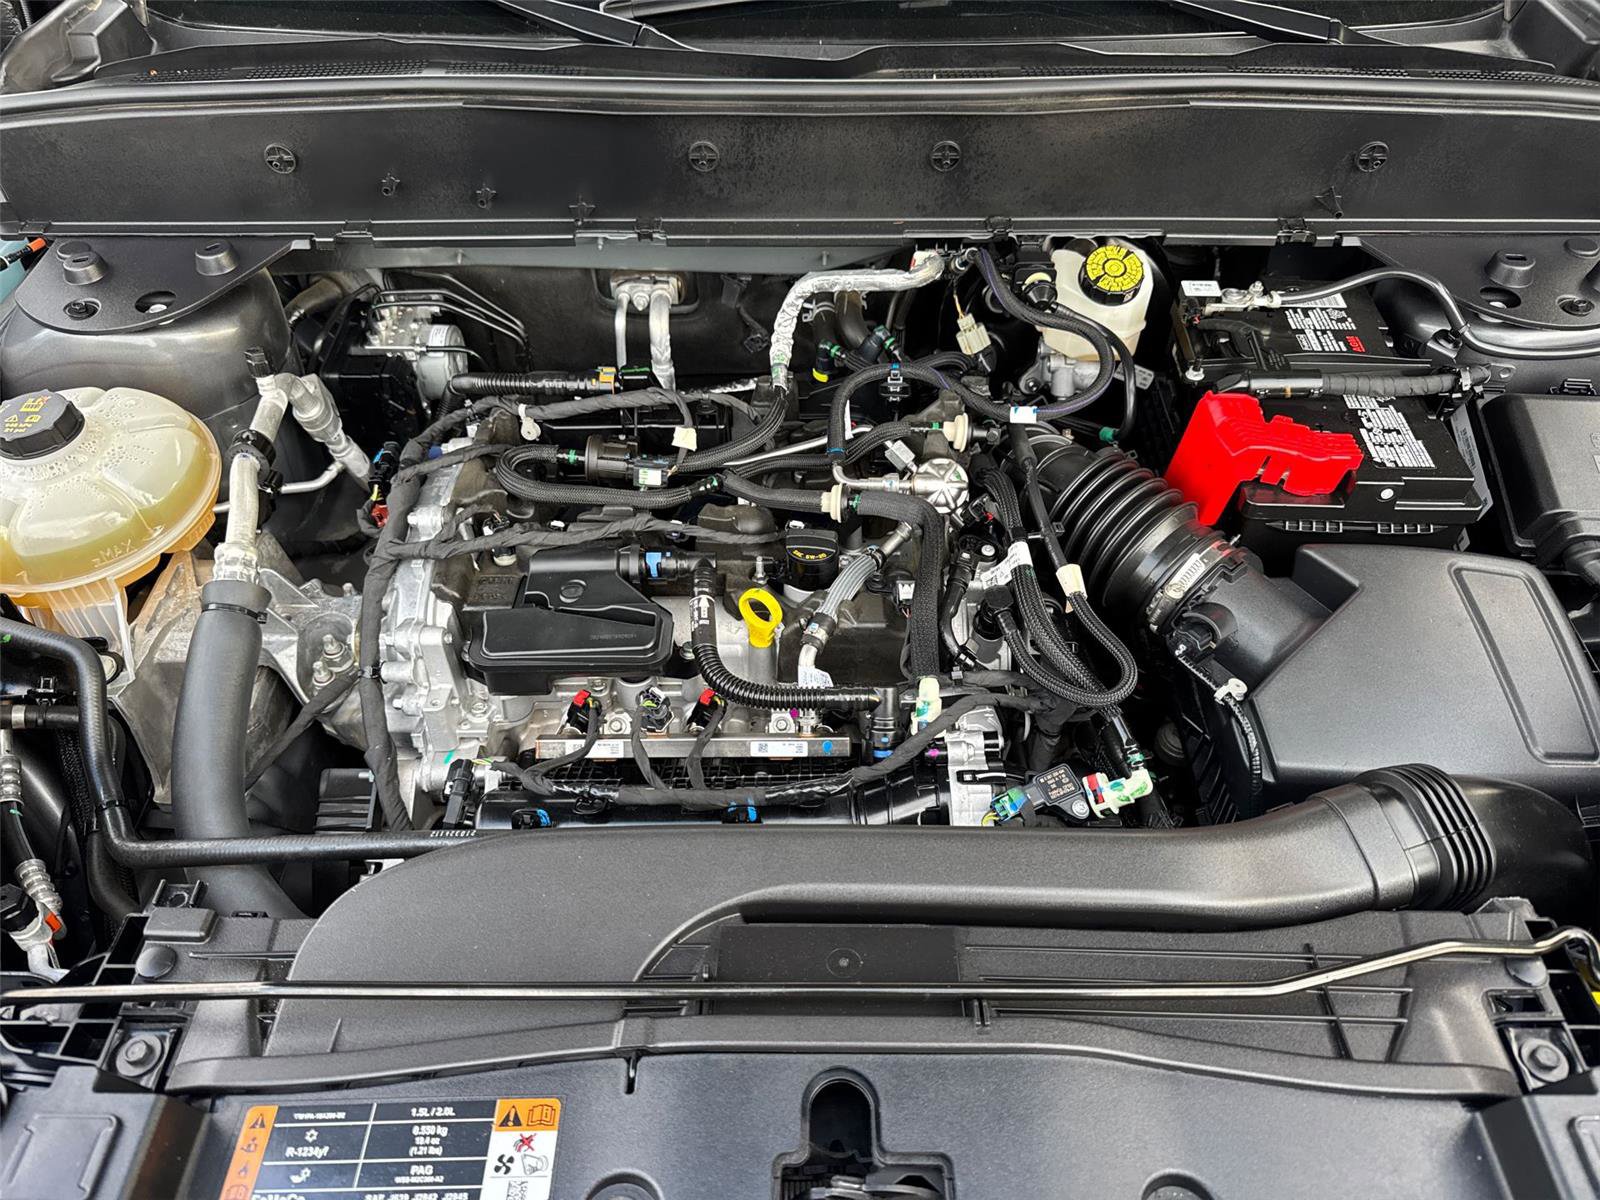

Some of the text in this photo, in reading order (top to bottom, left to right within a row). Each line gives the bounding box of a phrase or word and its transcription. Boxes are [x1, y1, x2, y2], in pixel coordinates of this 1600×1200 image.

[101, 538, 135, 562] MAX
[411, 1107, 429, 1117] 1.5L
[435, 1106, 456, 1117] 2.0L
[437, 1125, 448, 1137] kg
[285, 1146, 330, 1159] R-1234yf
[410, 1164, 434, 1175] PAG
